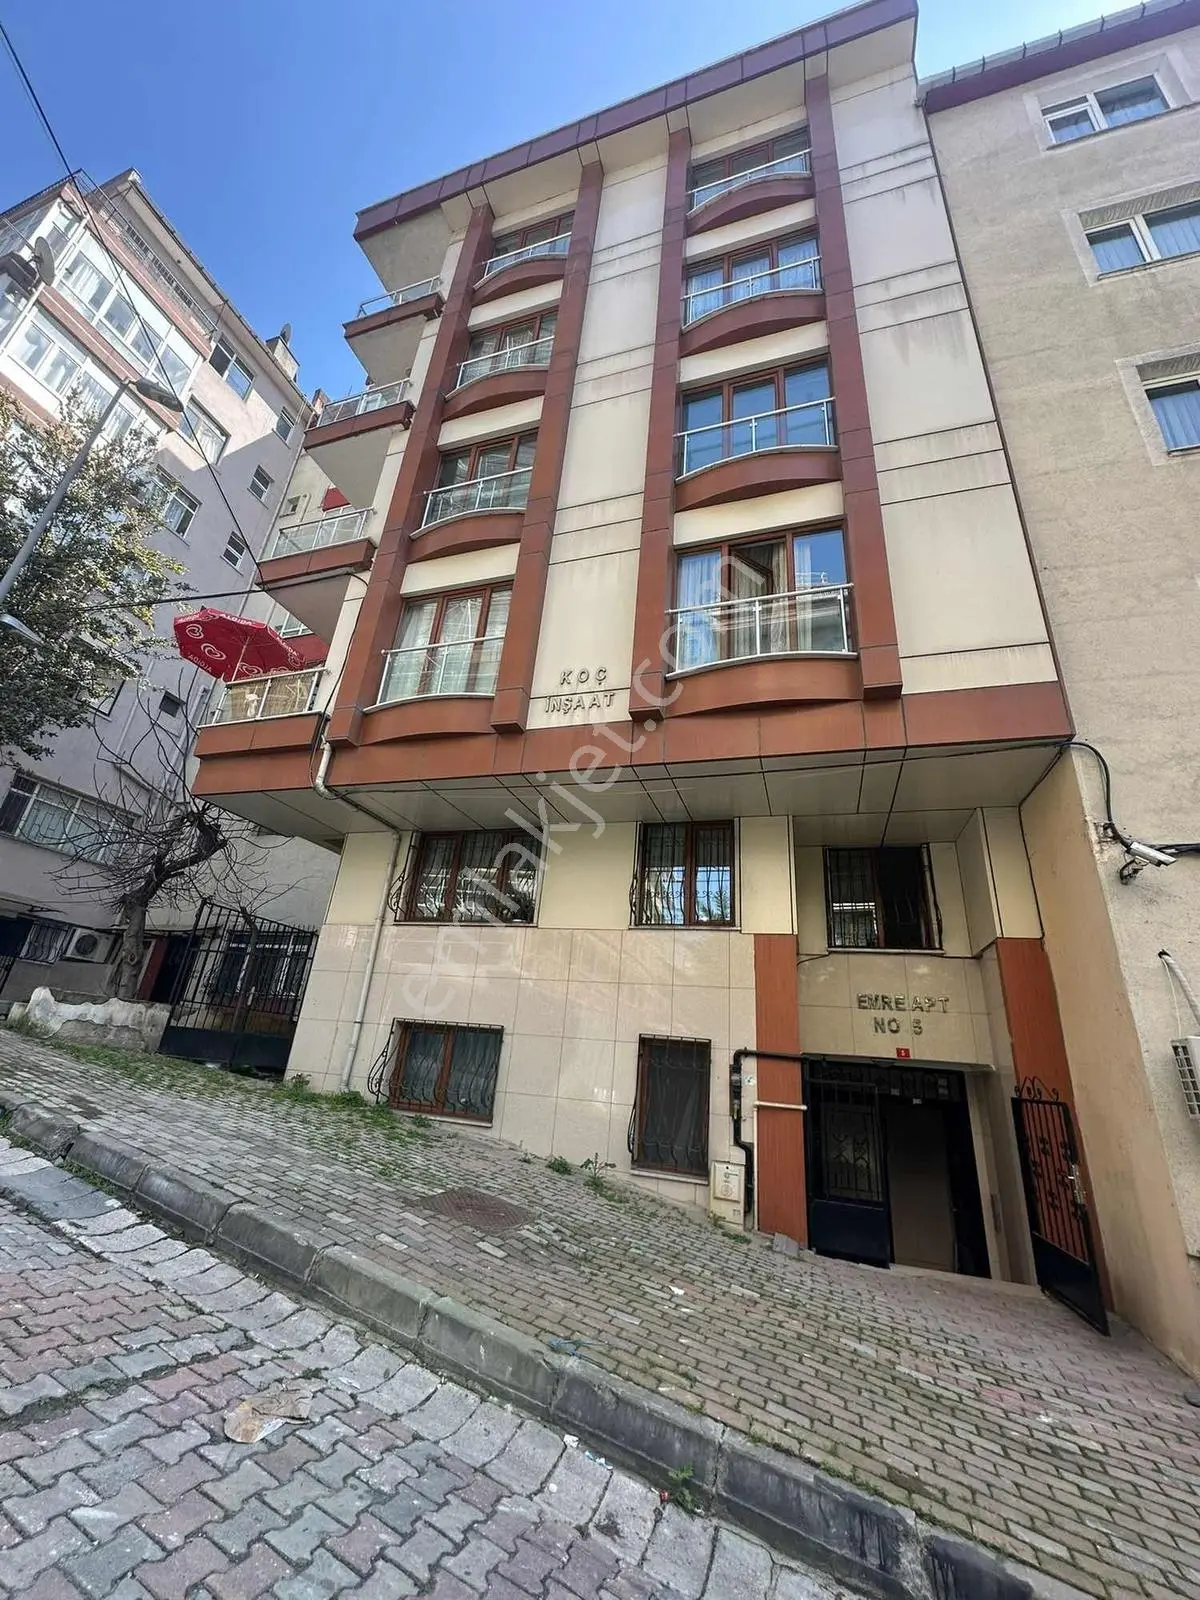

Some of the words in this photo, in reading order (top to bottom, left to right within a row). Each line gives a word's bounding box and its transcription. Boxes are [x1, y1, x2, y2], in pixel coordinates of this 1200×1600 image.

[560, 667, 607, 685] KOÇ
[544, 691, 615, 714] İNŞAAT
[857, 993, 906, 1011] EMRE
[911, 995, 950, 1014] APT
[873, 1016, 900, 1034] NO
